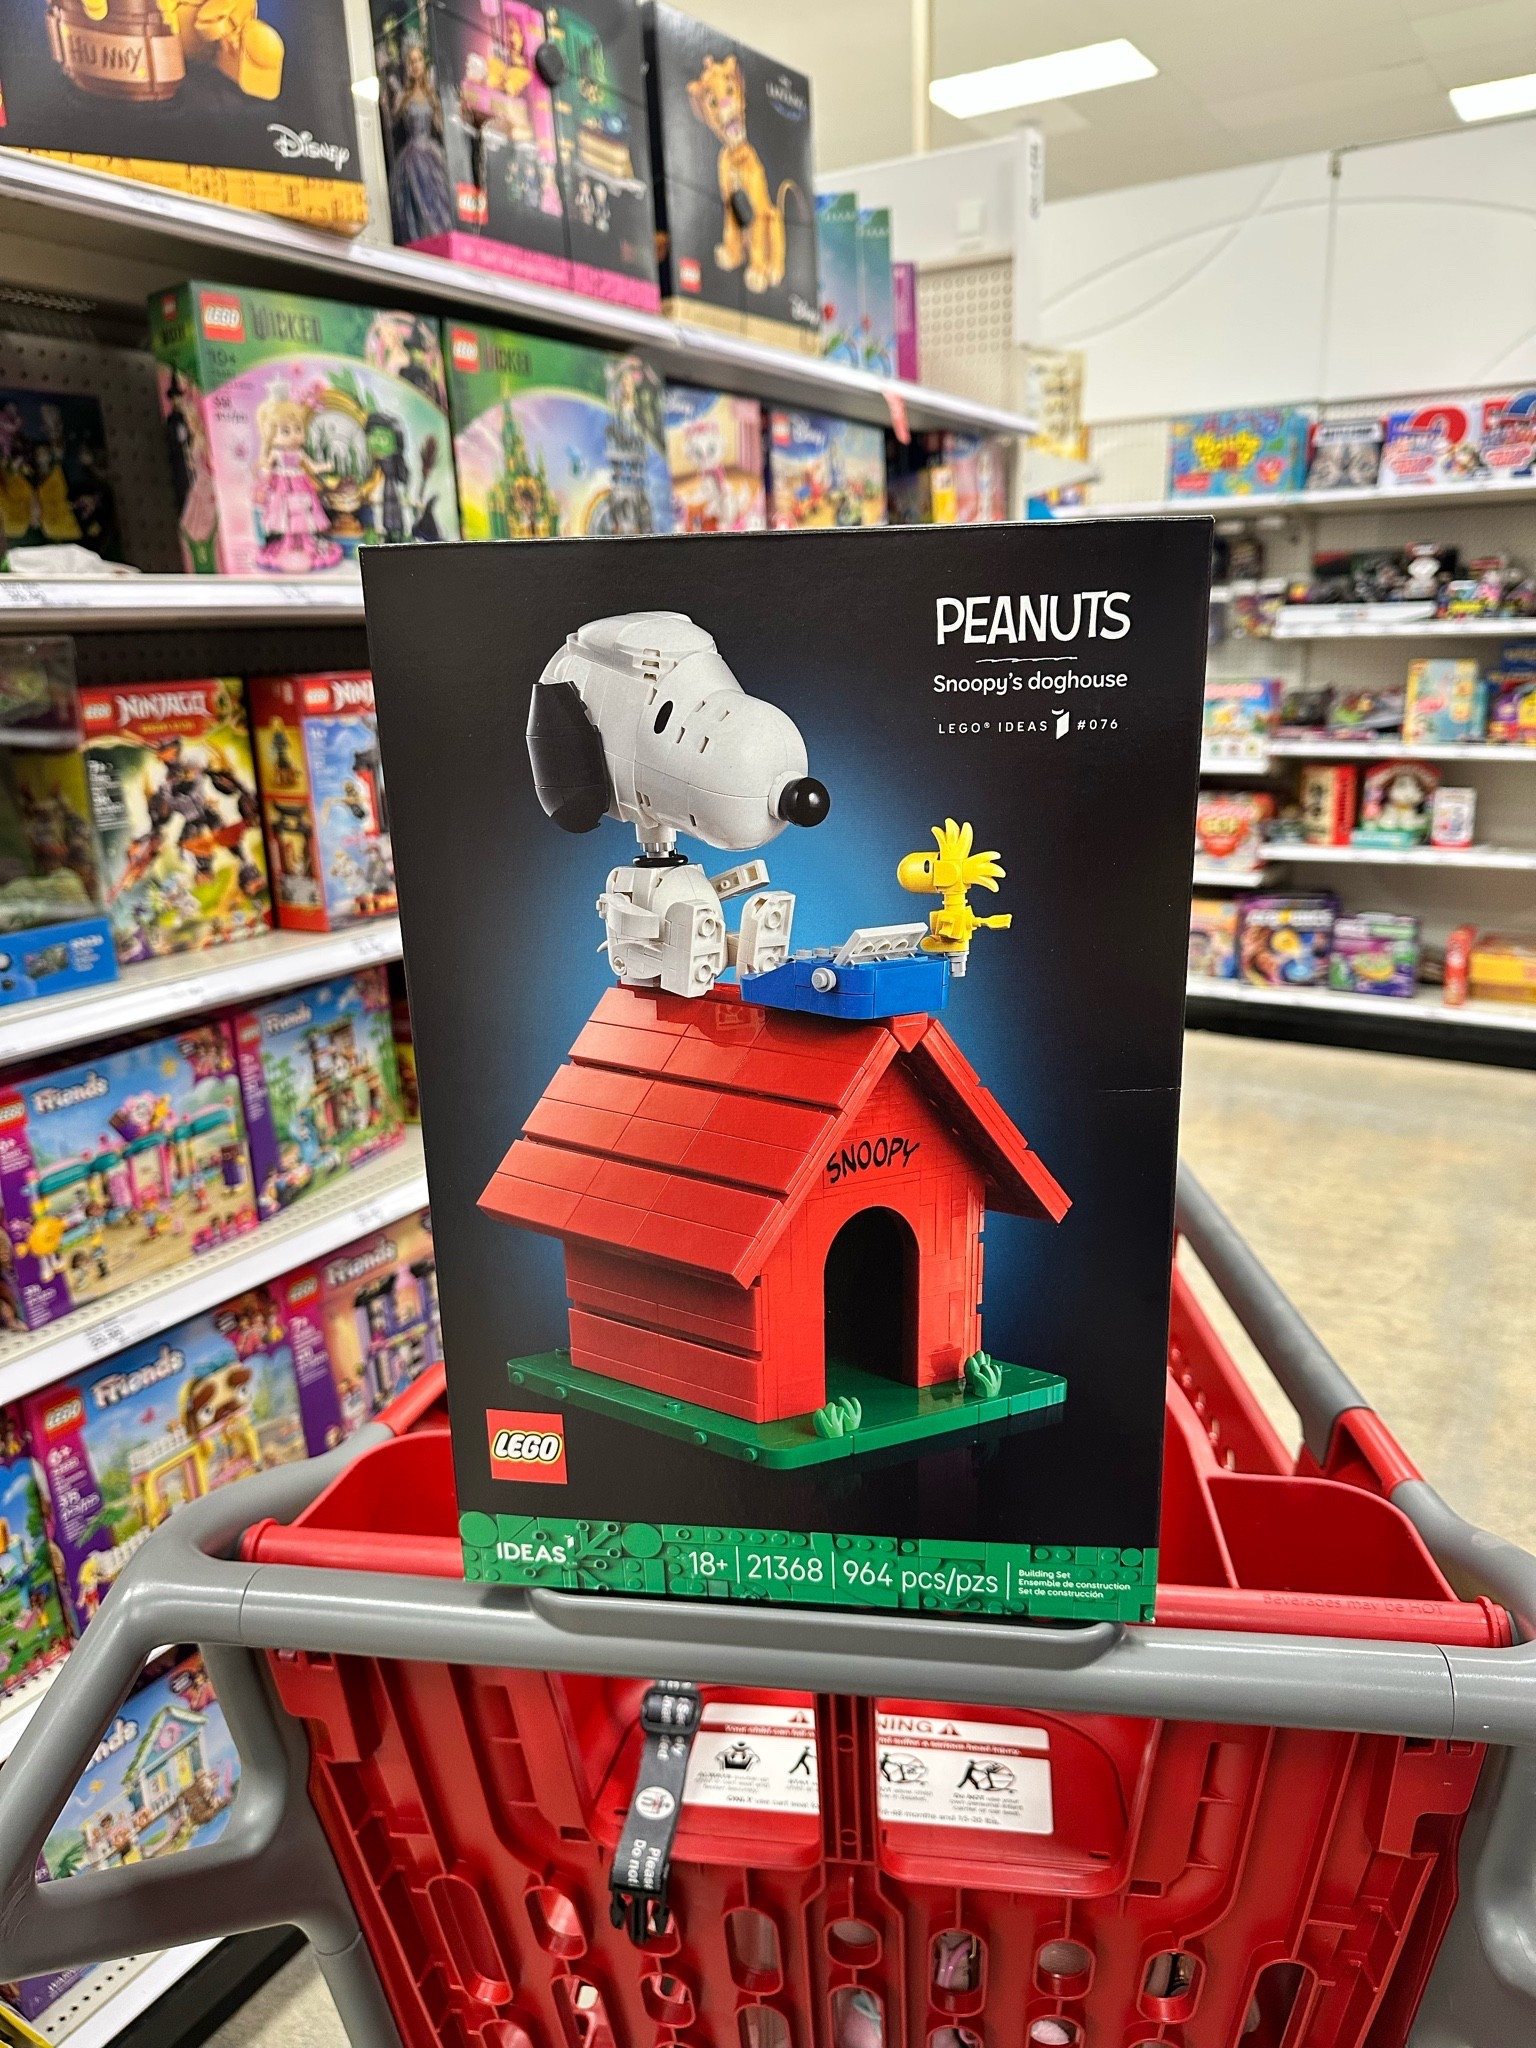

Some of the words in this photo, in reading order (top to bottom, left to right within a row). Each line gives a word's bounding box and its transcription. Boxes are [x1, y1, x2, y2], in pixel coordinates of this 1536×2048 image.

[70, 37, 143, 72] HUNNY
[266, 122, 350, 172] Disney
[936, 590, 1132, 645] PEANUTS
[933, 672, 1023, 696] Snoopy's
[1028, 670, 1128, 694] doghouse
[115, 690, 212, 727] NINJAGO
[998, 720, 1048, 733] IDEAS
[1077, 718, 1119, 730] #076
[31, 1070, 108, 1115] Friends
[826, 1137, 920, 1184] SNOOPY
[325, 1235, 397, 1290] Friends
[90, 1344, 186, 1408] Friends
[45, 1398, 83, 1430] LEGO
[494, 1431, 561, 1461] LEGO
[497, 1542, 567, 1563] IDEAS
[688, 1551, 728, 1576] 18+
[747, 1554, 823, 1582] 21368
[843, 1560, 893, 1587] 964
[902, 1567, 998, 1597] pcs/pzs
[1018, 1569, 1054, 1580] Building
[1055, 1570, 1071, 1579] Set
[1018, 1578, 1061, 1588] Ensemble
[1062, 1580, 1074, 1588] de
[1075, 1582, 1131, 1591] construction
[1018, 1587, 1033, 1595] Set
[1034, 1588, 1046, 1596] de
[1047, 1589, 1104, 1599] construcción
[1263, 1593, 1341, 1612] Beverages
[1347, 1600, 1377, 1615] may
[1384, 1601, 1405, 1613] be
[1411, 1603, 1443, 1616] HOT
[878, 1717, 933, 1734] NING
[631, 1838, 647, 1859] Do
